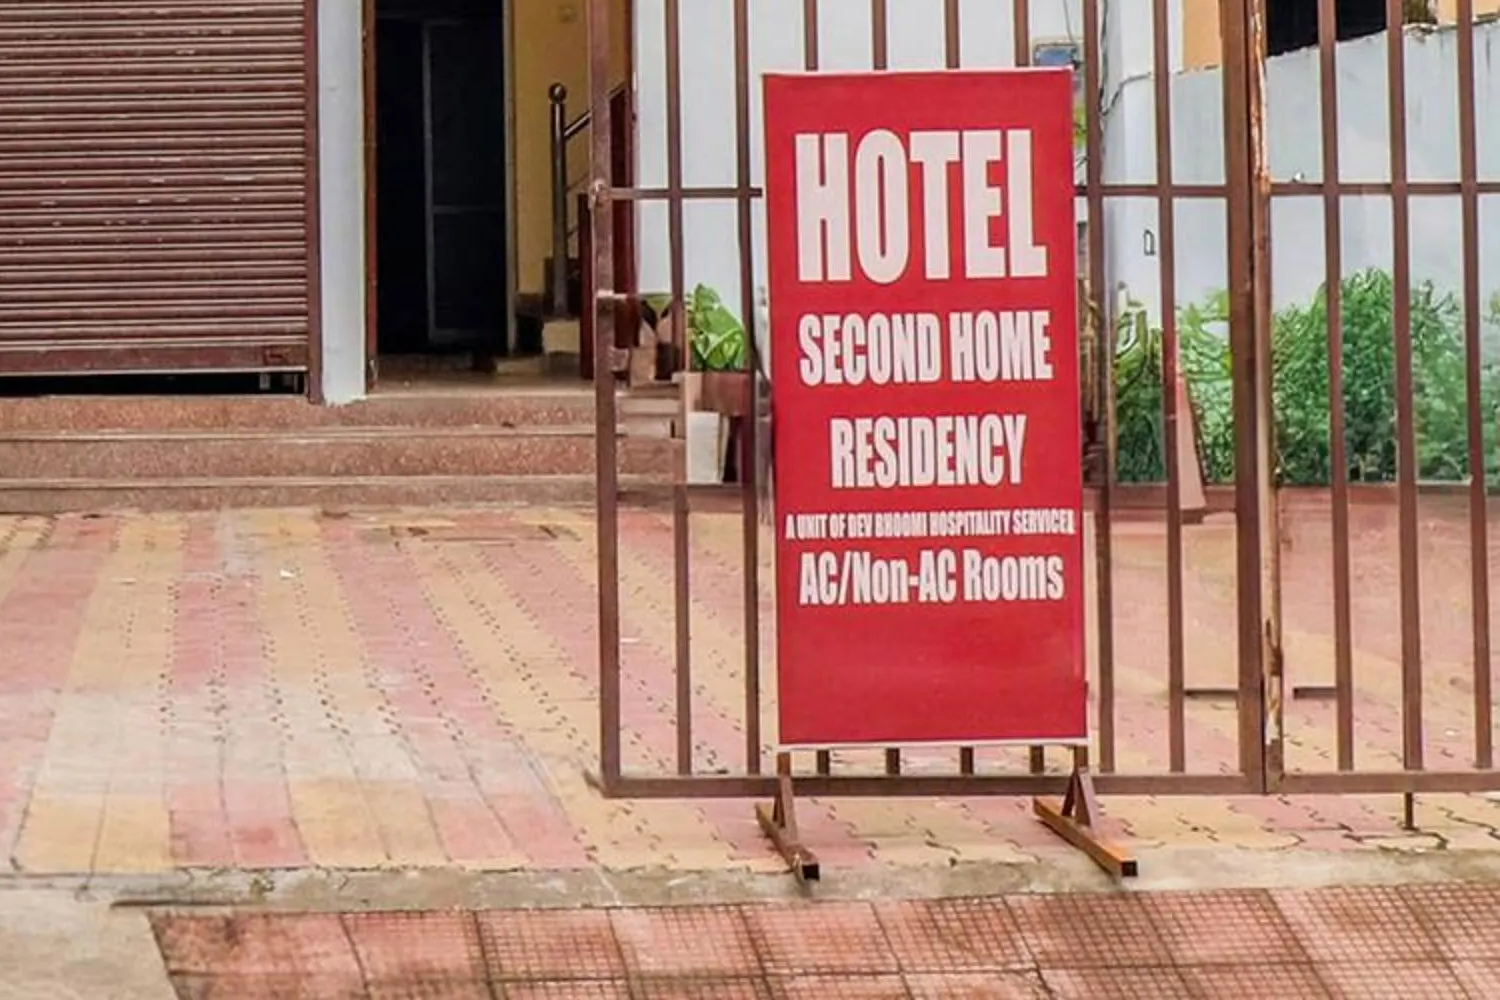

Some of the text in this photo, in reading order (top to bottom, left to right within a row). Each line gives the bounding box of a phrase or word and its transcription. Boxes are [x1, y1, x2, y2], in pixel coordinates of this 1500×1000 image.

[794, 129, 1049, 284] HOTEL
[799, 310, 1054, 386] SECOND HOME
[830, 414, 1027, 489] RESIDENCY
[785, 514, 797, 540] A
[797, 514, 828, 540] UNIT
[829, 514, 847, 538] OF
[929, 510, 1011, 537] HOSPITALITY
[799, 549, 1065, 606] AC/Non-AC Rooms
